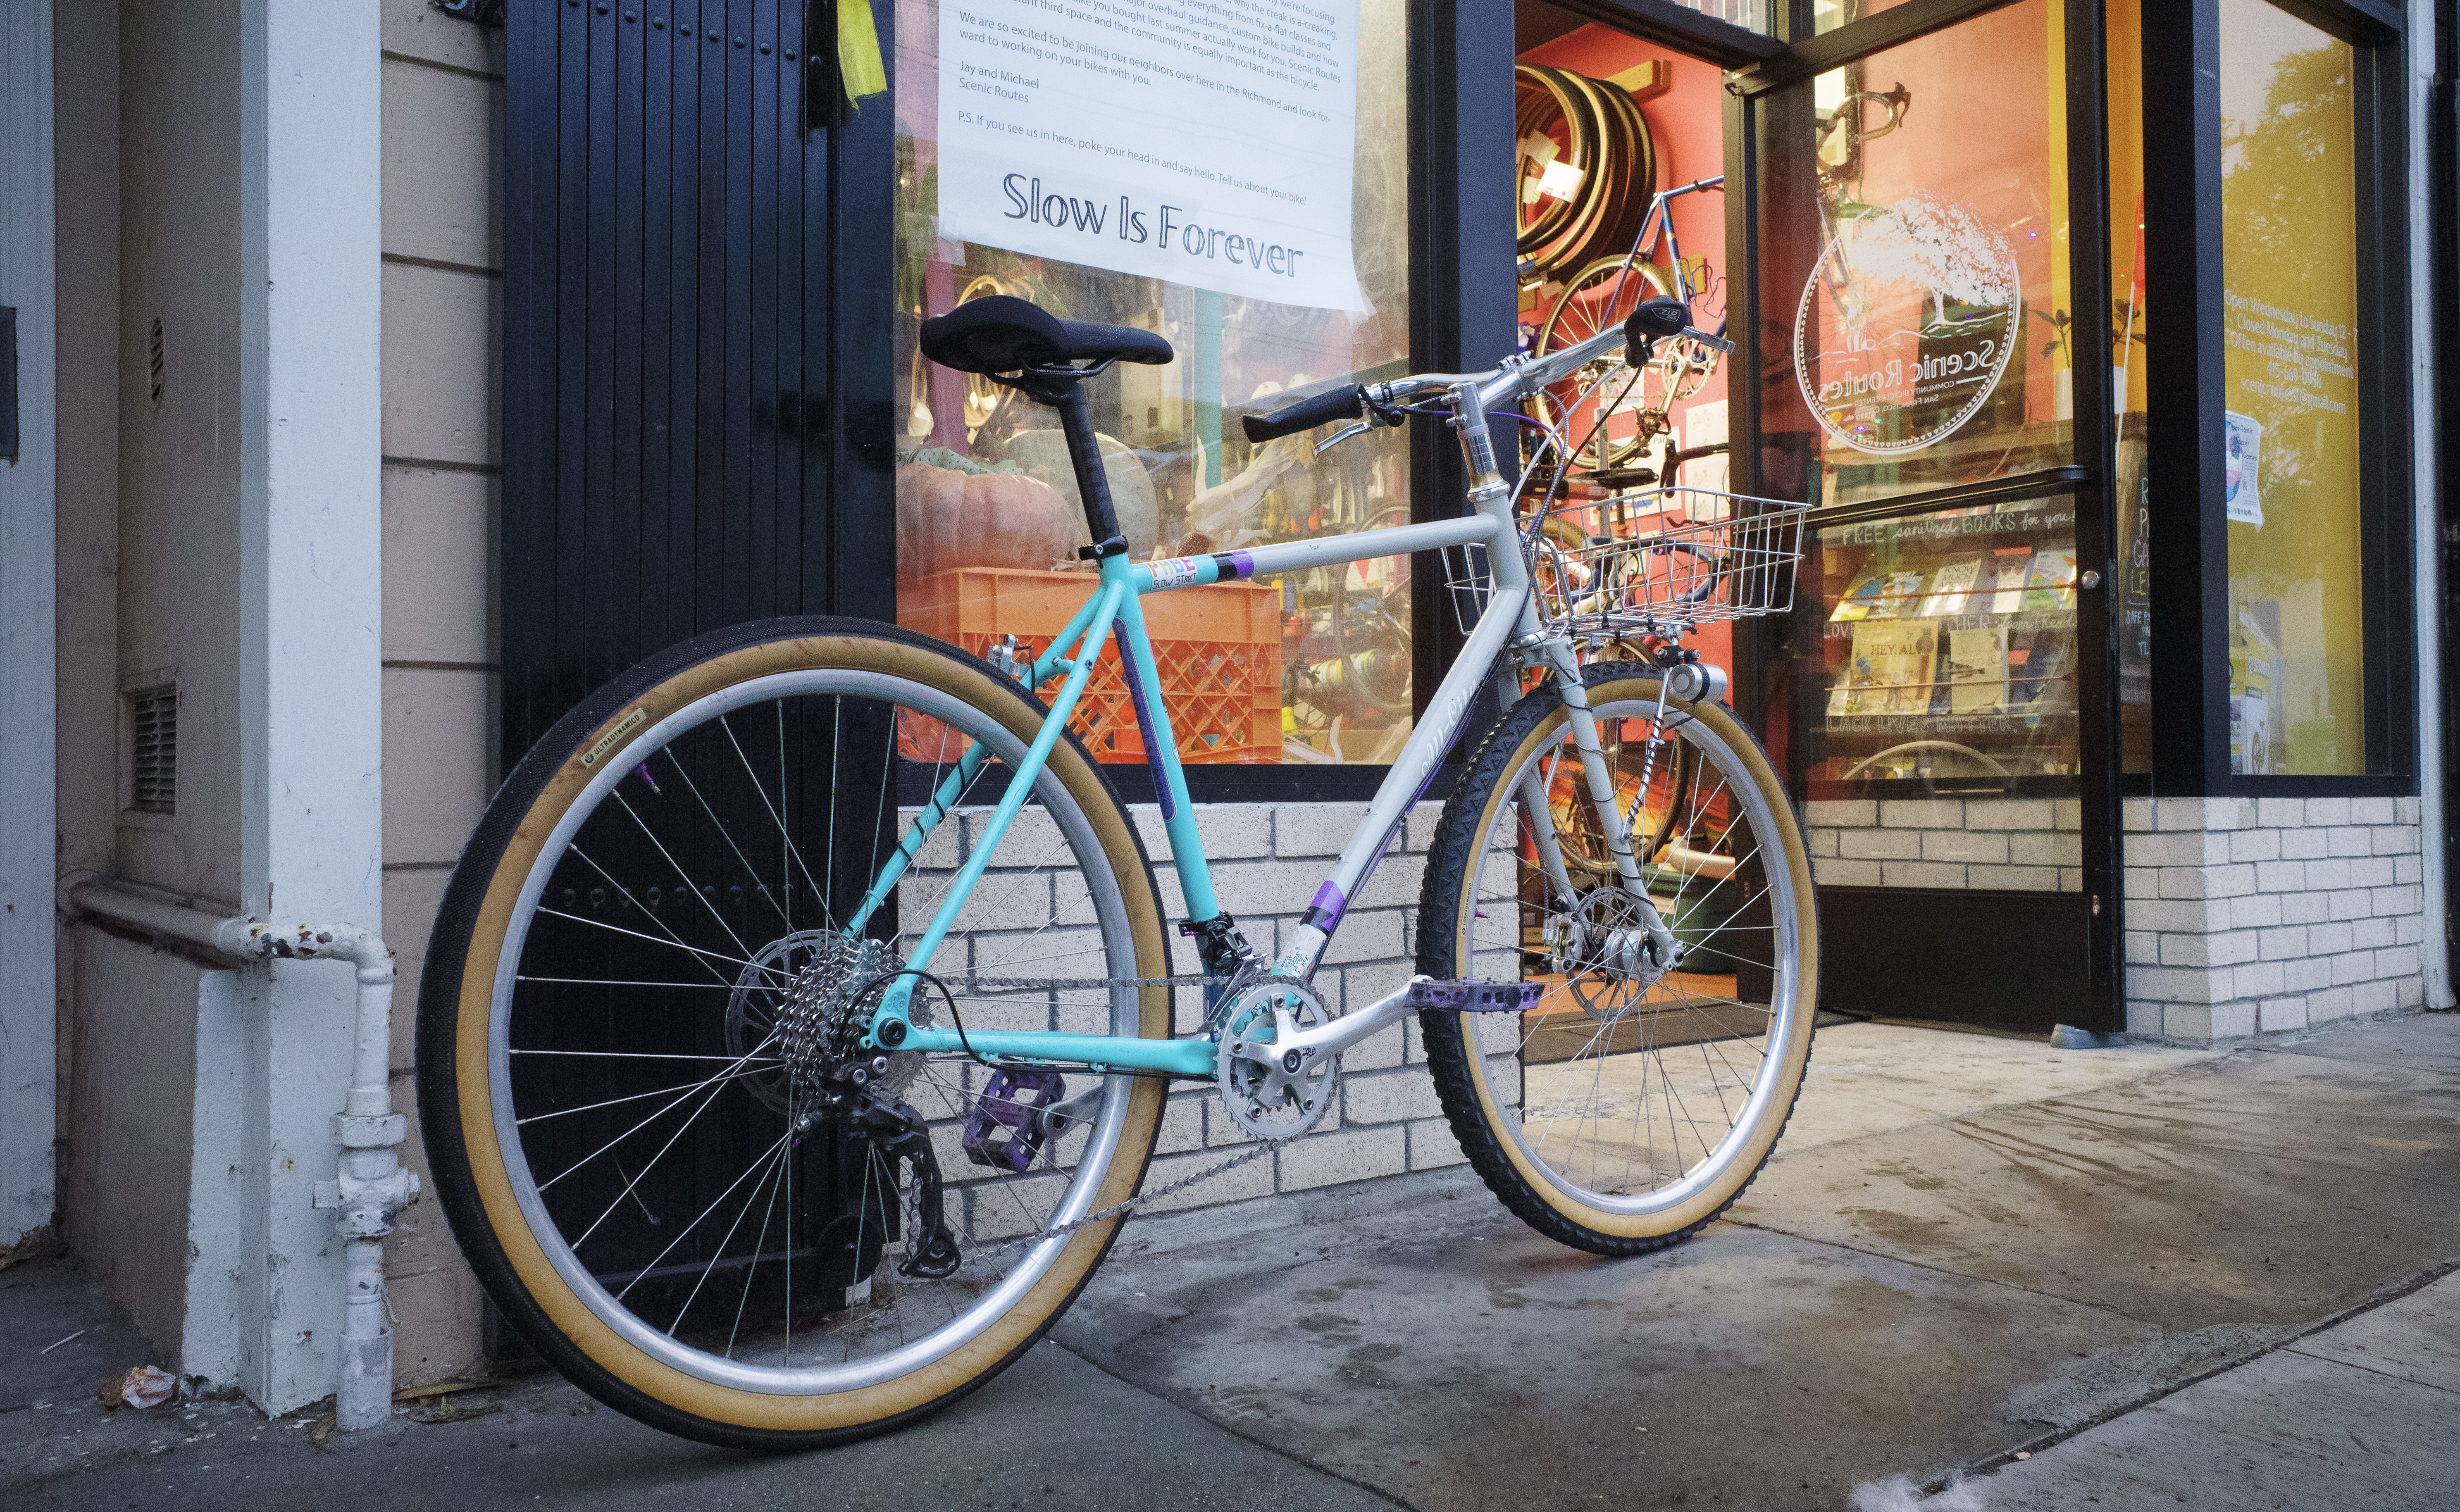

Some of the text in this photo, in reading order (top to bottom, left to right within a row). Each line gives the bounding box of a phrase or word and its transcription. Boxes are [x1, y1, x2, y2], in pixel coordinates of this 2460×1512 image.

[1148, 2, 1186, 20] overhaul
[1189, 14, 1230, 33] guidance,
[1232, 27, 1261, 40] custom
[1263, 35, 1279, 49] bike
[1281, 41, 1304, 57] builds
[1306, 53, 1321, 62] and
[1323, 55, 1339, 67] how
[1187, 1, 1331, 51] everything from fix-a-flat classes and
[1234, 0, 1249, 11] why
[1252, 3, 1264, 14] the
[1266, 9, 1287, 22] creak
[1290, 15, 1295, 24] is
[1297, 19, 1338, 40] a-creaking,
[1281, 0, 1335, 25] we're focusing
[960, 29, 1151, 87] ward to working on your bikes with you.
[1041, 0, 1063, 14] third
[1066, 8, 1092, 22] space
[1095, 16, 1111, 28] and
[1115, 21, 1129, 33] the
[1132, 28, 1181, 50] community
[1184, 41, 1190, 51] is
[1193, 45, 1223, 62] equally
[1225, 53, 1265, 74] important
[1266, 69, 1274, 77] as
[1276, 70, 1289, 82] the
[1291, 74, 1320, 91] bicycle.
[1094, 1, 1110, 12] you
[1113, 4, 1146, 22] bought
[1148, 14, 1163, 29] last
[1166, 22, 1201, 39] summer
[1203, 33, 1235, 51] actually
[1237, 43, 1256, 56] work
[1259, 49, 1269, 60] for
[1271, 54, 1287, 67] you.
[1289, 59, 1313, 75] Scenic
[1316, 67, 1341, 83] Routes
[959, 61, 1039, 88] Jay and Michael
[959, 78, 1029, 103] Scenic Routes
[960, 11, 1331, 123] We are so excited to be joining our neighbors over here in the Richmond and look for-
[958, 110, 1306, 205] P.S. If you see us in here, poke your head in and say hello. Tell us about your bike!
[1004, 173, 1107, 234] Slow
[1120, 196, 1148, 243] Is
[1159, 205, 1304, 278] Forever
[2224, 289, 2248, 311] Open
[2250, 296, 2298, 330] Wednesday
[2300, 311, 2308, 329] to
[2310, 315, 2337, 342] Sunday
[2338, 324, 2346, 339] 12
[2353, 327, 2358, 343] 7
[2237, 313, 2347, 363] Closed Monday and Tuesday
[2230, 331, 2354, 379] Often available by appointment
[1842, 509, 2075, 545] FREE sanitized BOOKS for you!
[1152, 573, 1197, 590] SLOW STREET
[1870, 644, 1916, 655] HEY, AL
[594, 714, 640, 755] ULTRADYNAMICO
[1877, 716, 1929, 733] LIVES
[1464, 882, 1472, 926] ULTRADYNAMICO
